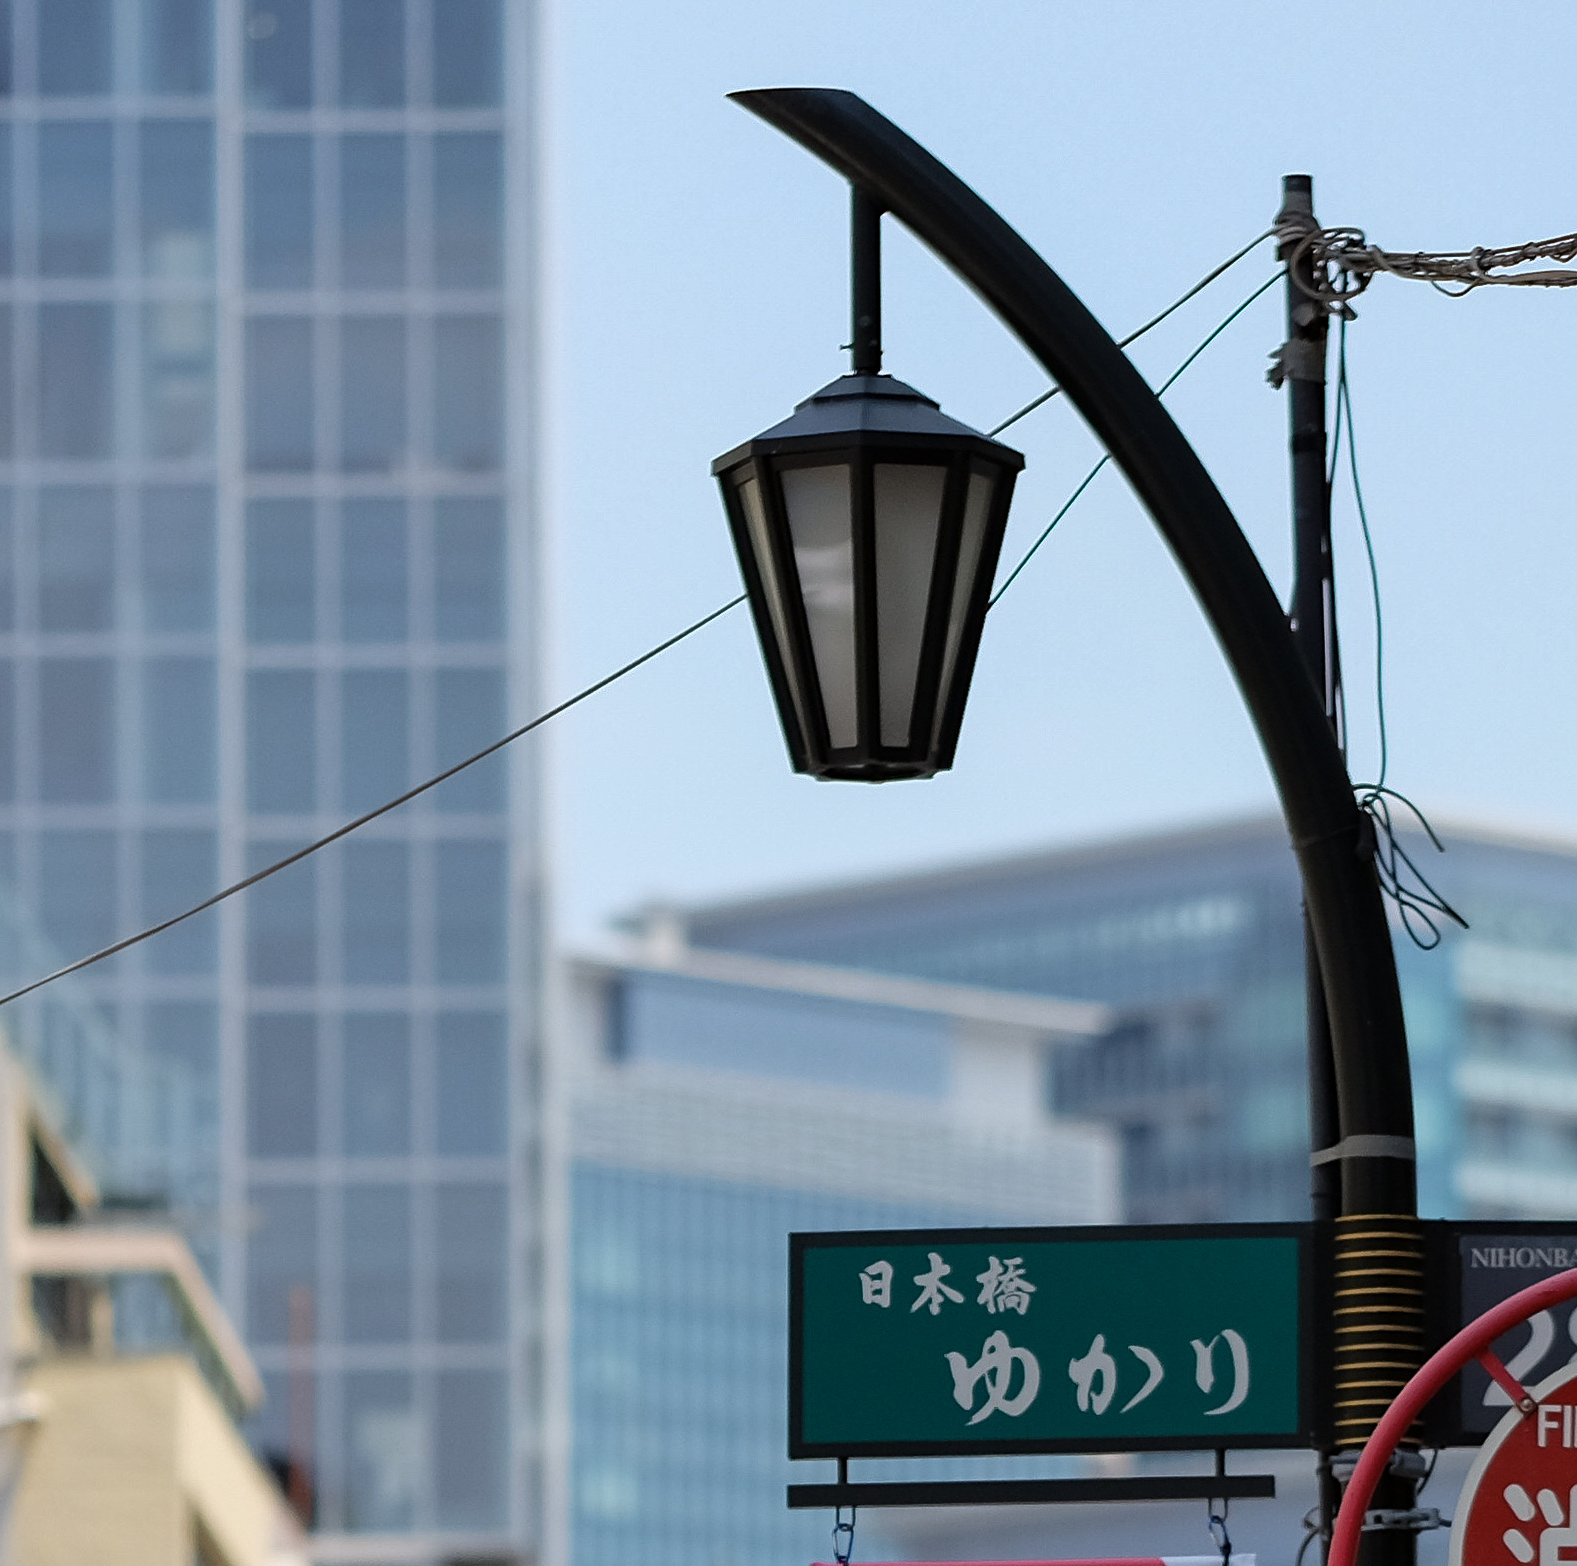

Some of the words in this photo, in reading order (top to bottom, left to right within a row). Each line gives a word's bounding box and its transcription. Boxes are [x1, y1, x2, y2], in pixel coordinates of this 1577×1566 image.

[859, 1252, 1037, 1316] 日本橋
[944, 1328, 1250, 1426] ゆかり
